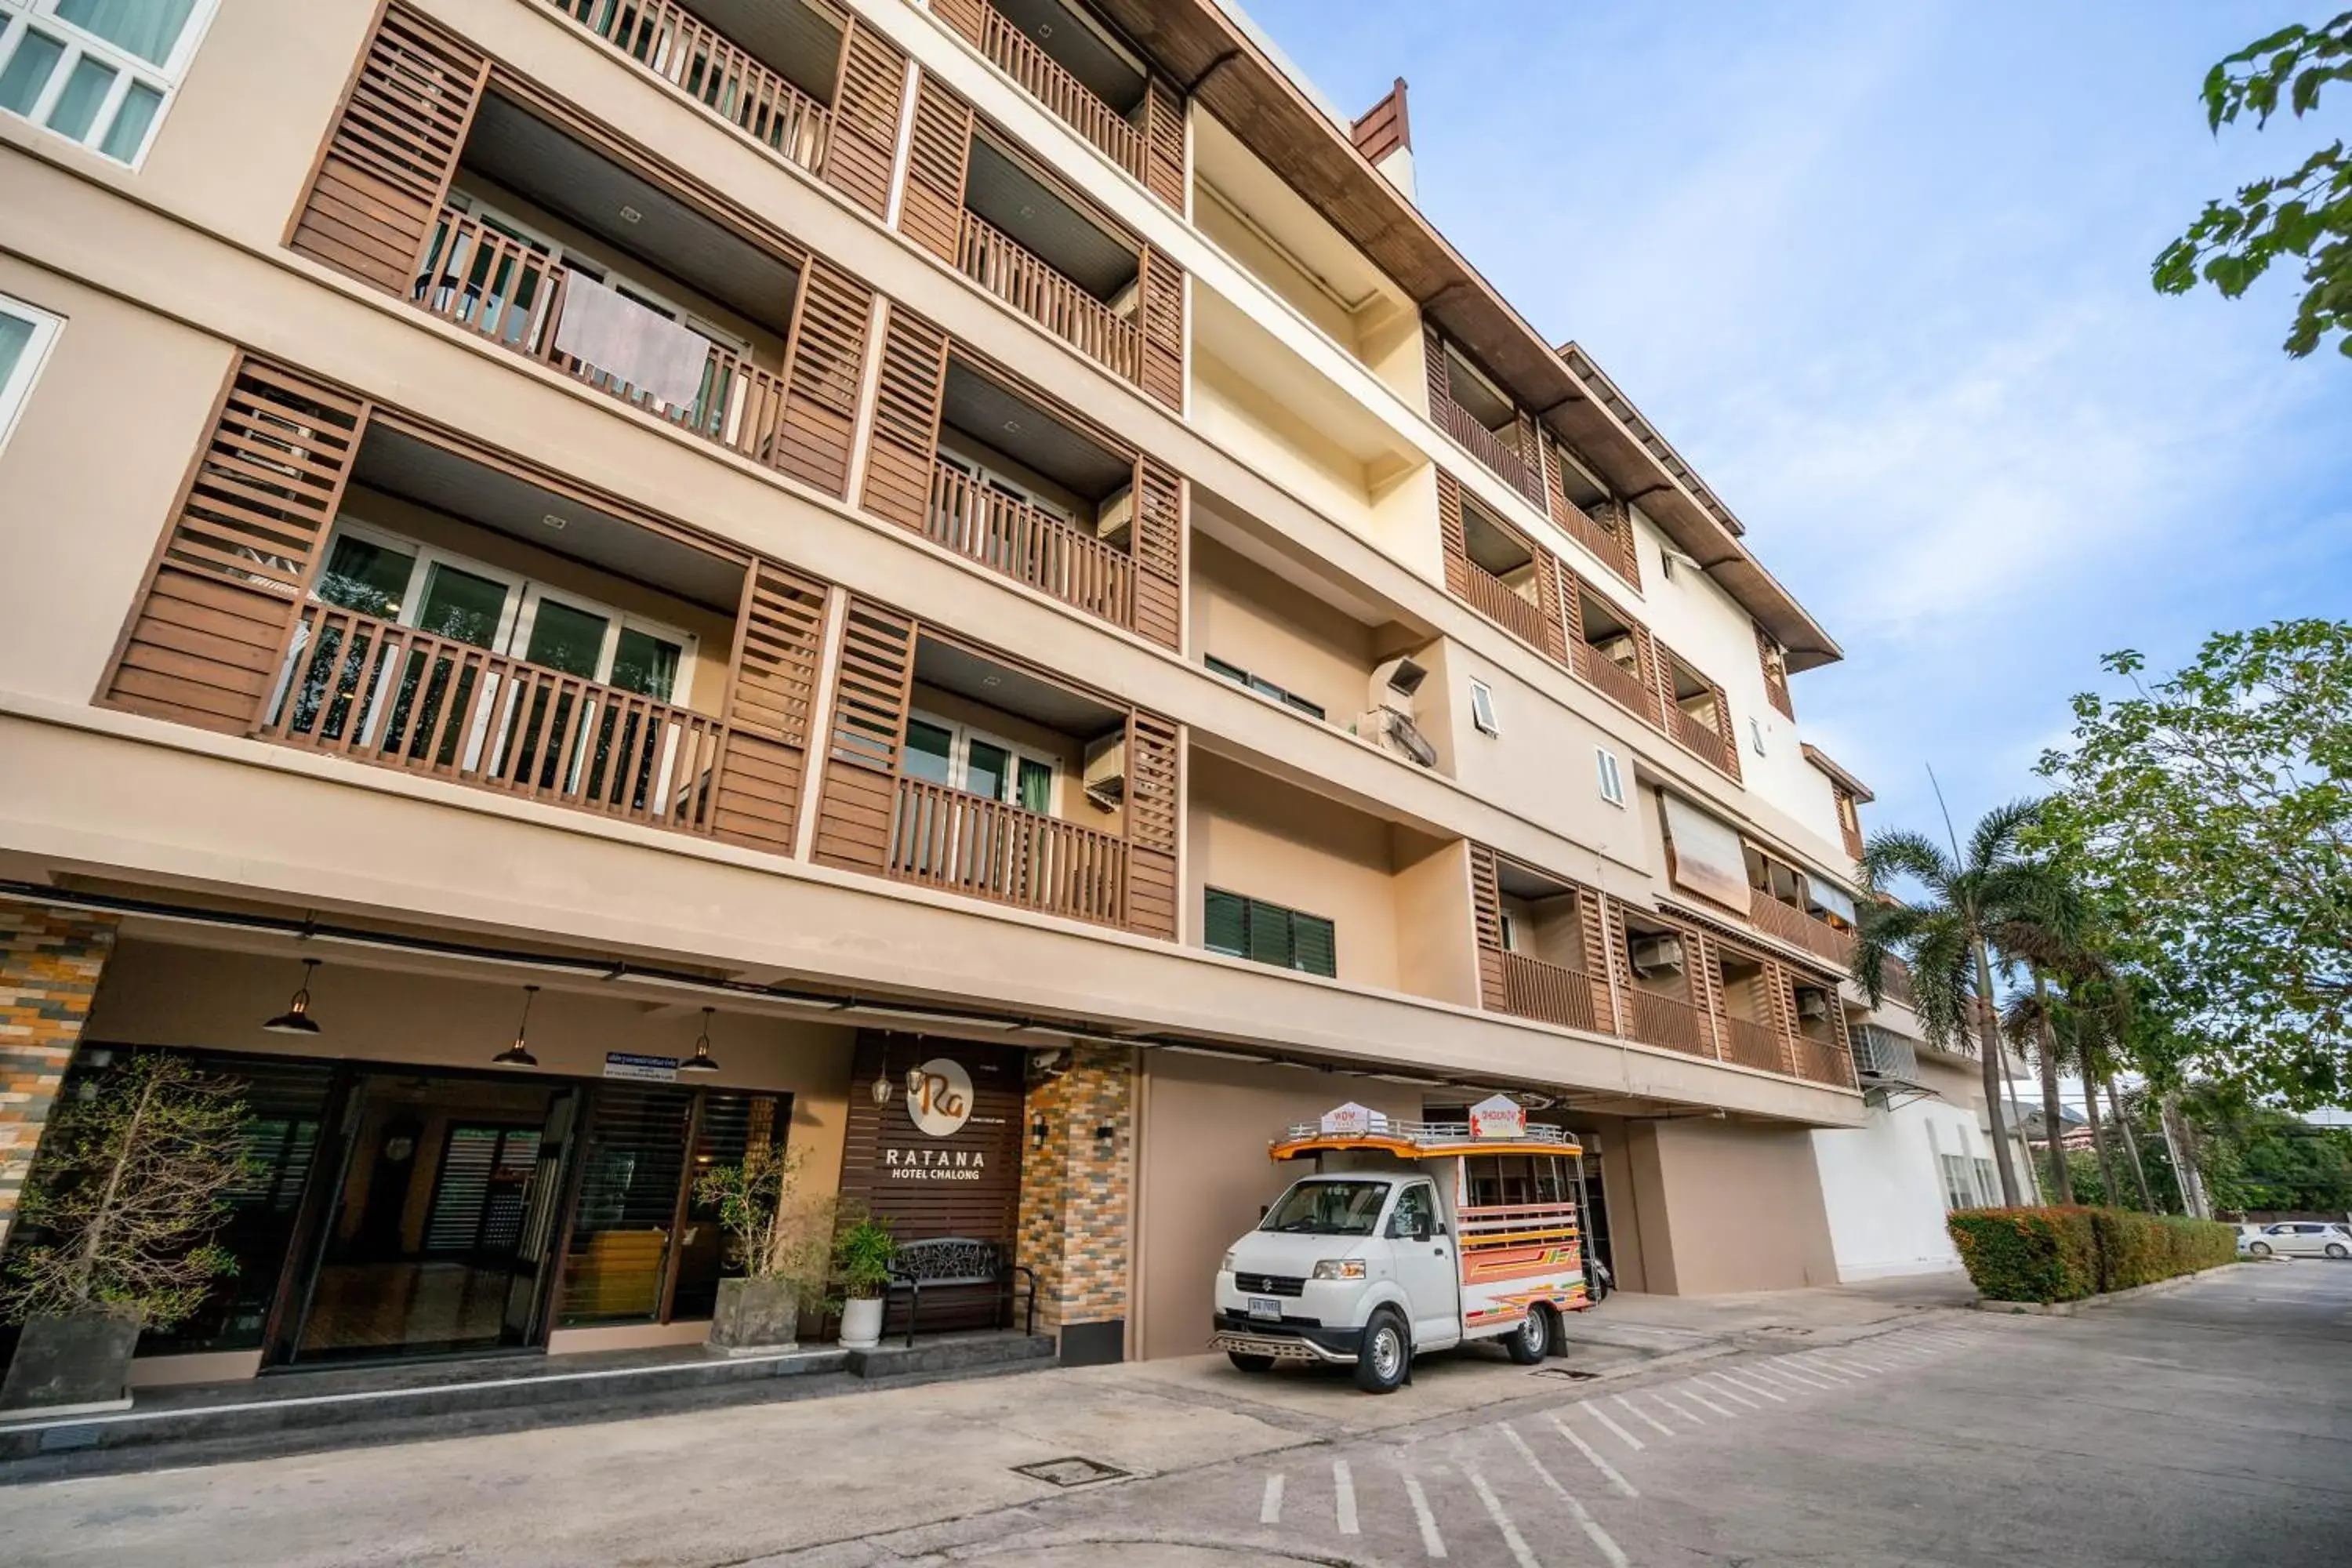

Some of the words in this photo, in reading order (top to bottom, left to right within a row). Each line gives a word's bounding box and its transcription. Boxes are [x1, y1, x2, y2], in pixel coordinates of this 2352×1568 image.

[886, 1149, 984, 1167] RATANA
[892, 1168, 928, 1179] HOTEL
[930, 1169, 980, 1180] CHALONG
